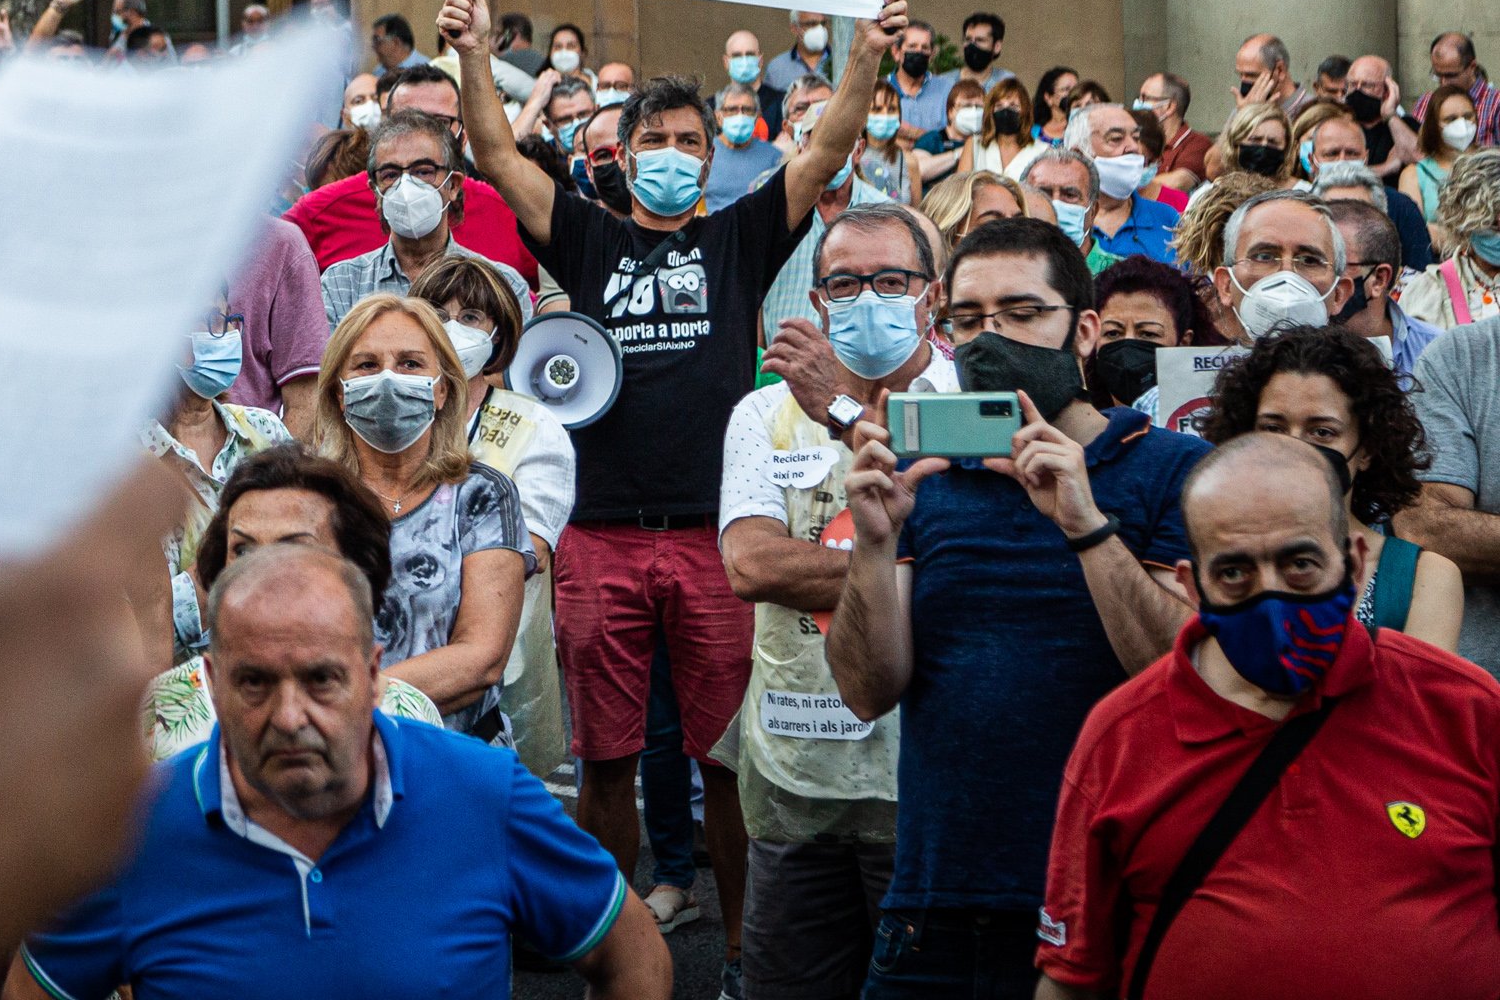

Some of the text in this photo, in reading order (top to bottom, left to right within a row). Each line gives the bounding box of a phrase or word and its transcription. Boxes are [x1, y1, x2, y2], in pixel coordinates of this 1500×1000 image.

[658, 323, 668, 338] a
[773, 451, 823, 464] Reciclar sí,
[773, 470, 804, 480] així no
[767, 692, 845, 709] Ni rates, ni rato
[768, 717, 780, 730] als
[781, 719, 811, 733] carrers
[813, 720, 817, 733] i
[820, 720, 838, 733] als
